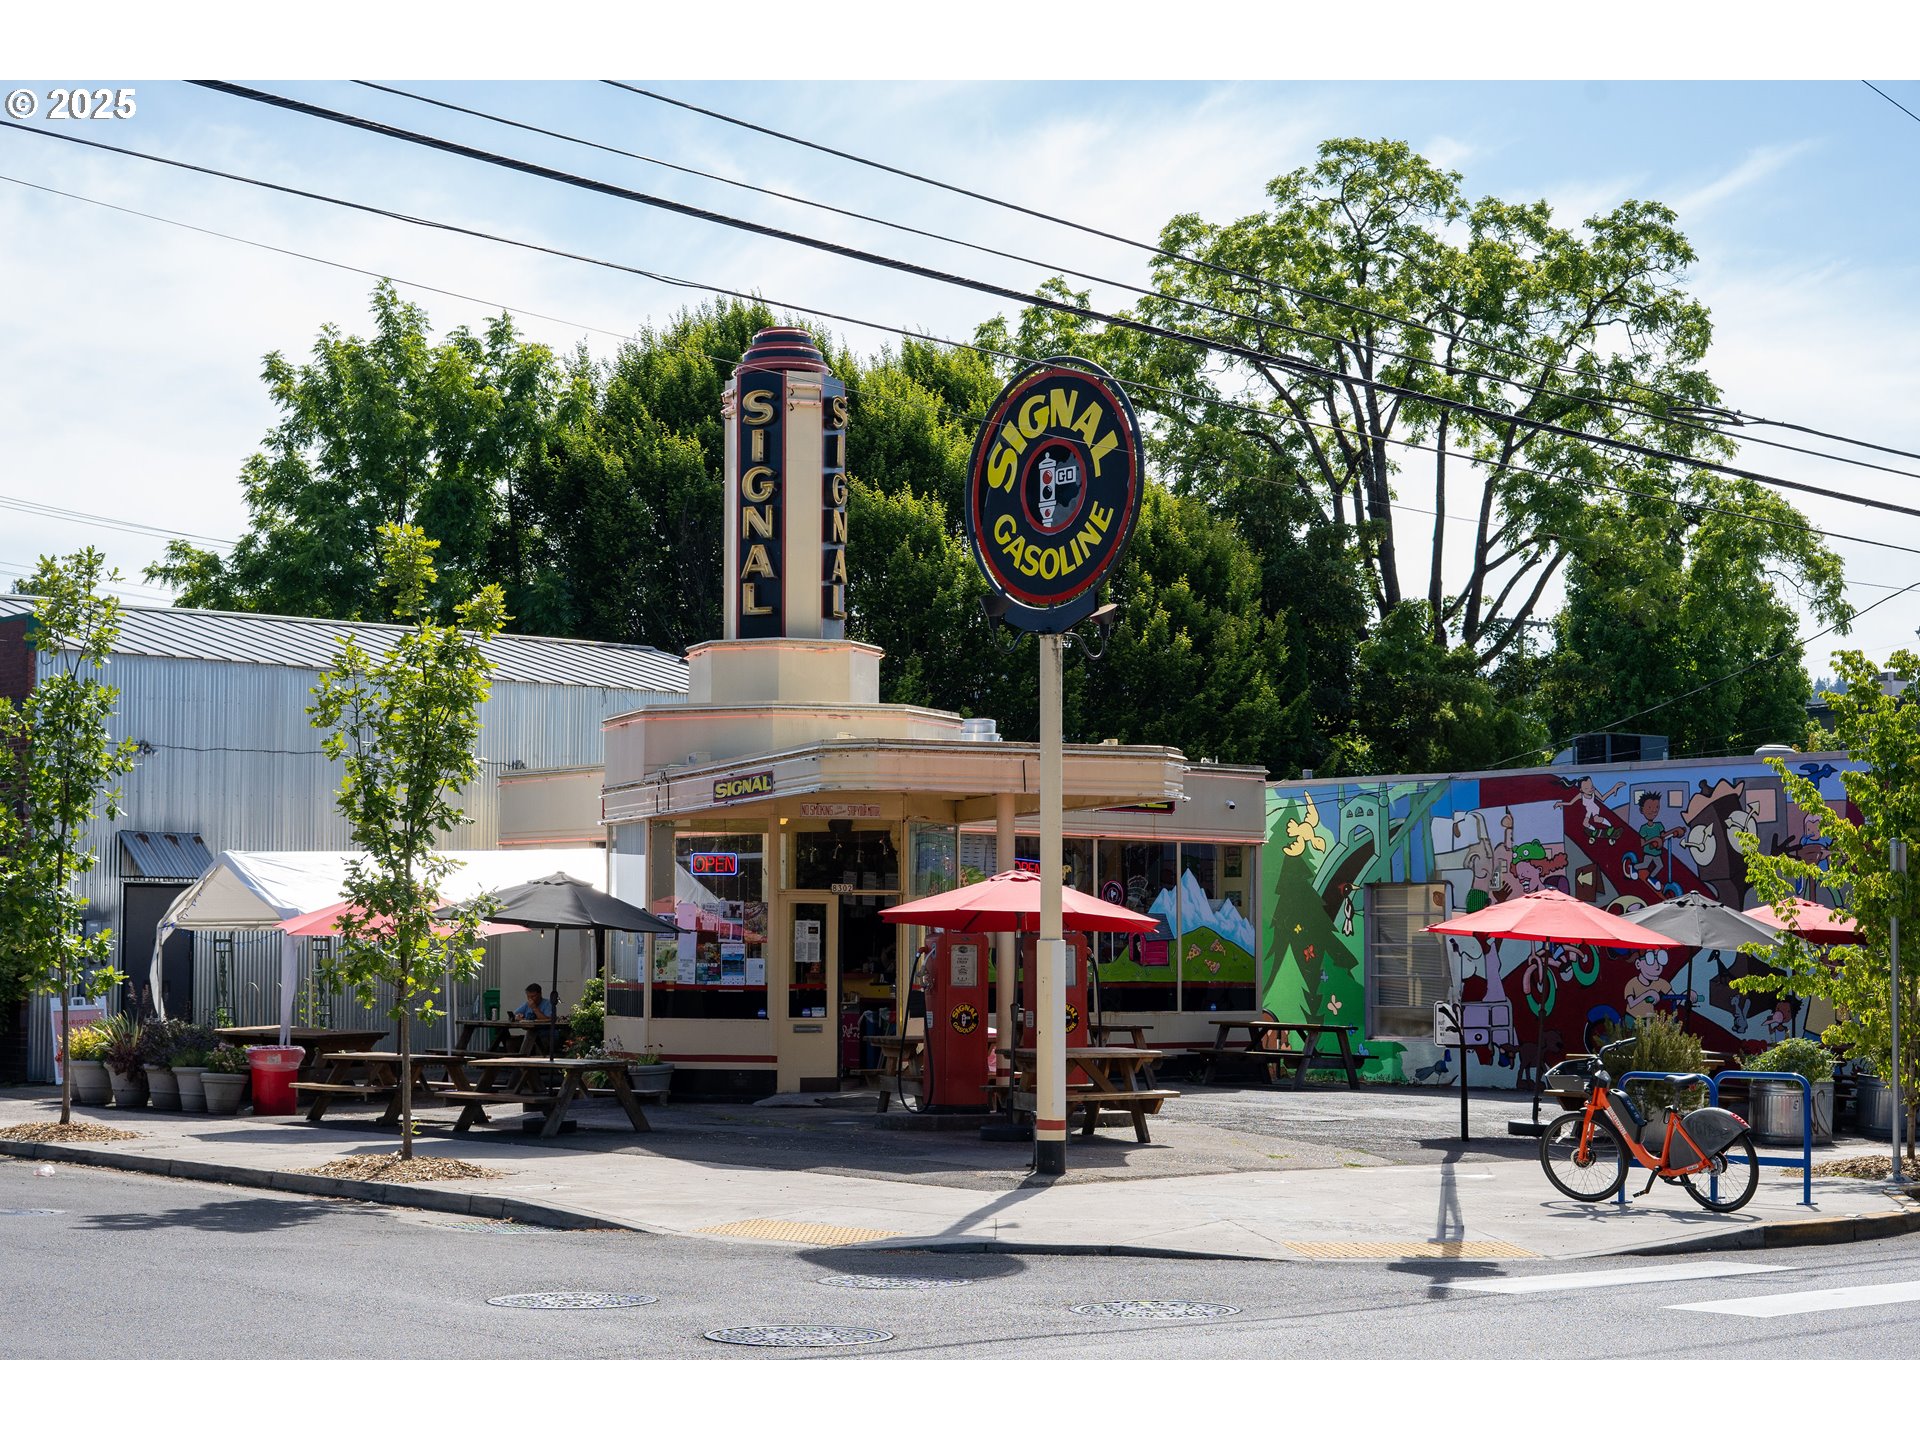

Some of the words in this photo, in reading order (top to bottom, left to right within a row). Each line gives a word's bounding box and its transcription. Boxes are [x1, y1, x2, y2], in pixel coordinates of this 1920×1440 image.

[987, 388, 1119, 493] SIGNAL
[1057, 468, 1074, 483] GO
[741, 389, 777, 616] SIGNAL
[832, 395, 849, 620] SIGNAL
[993, 500, 1115, 580] GASOLINE
[714, 775, 772, 799] SIGNAL
[693, 855, 735, 873] OPEN
[832, 884, 853, 892] 8302
[951, 1004, 978, 1019] SIGNAL
